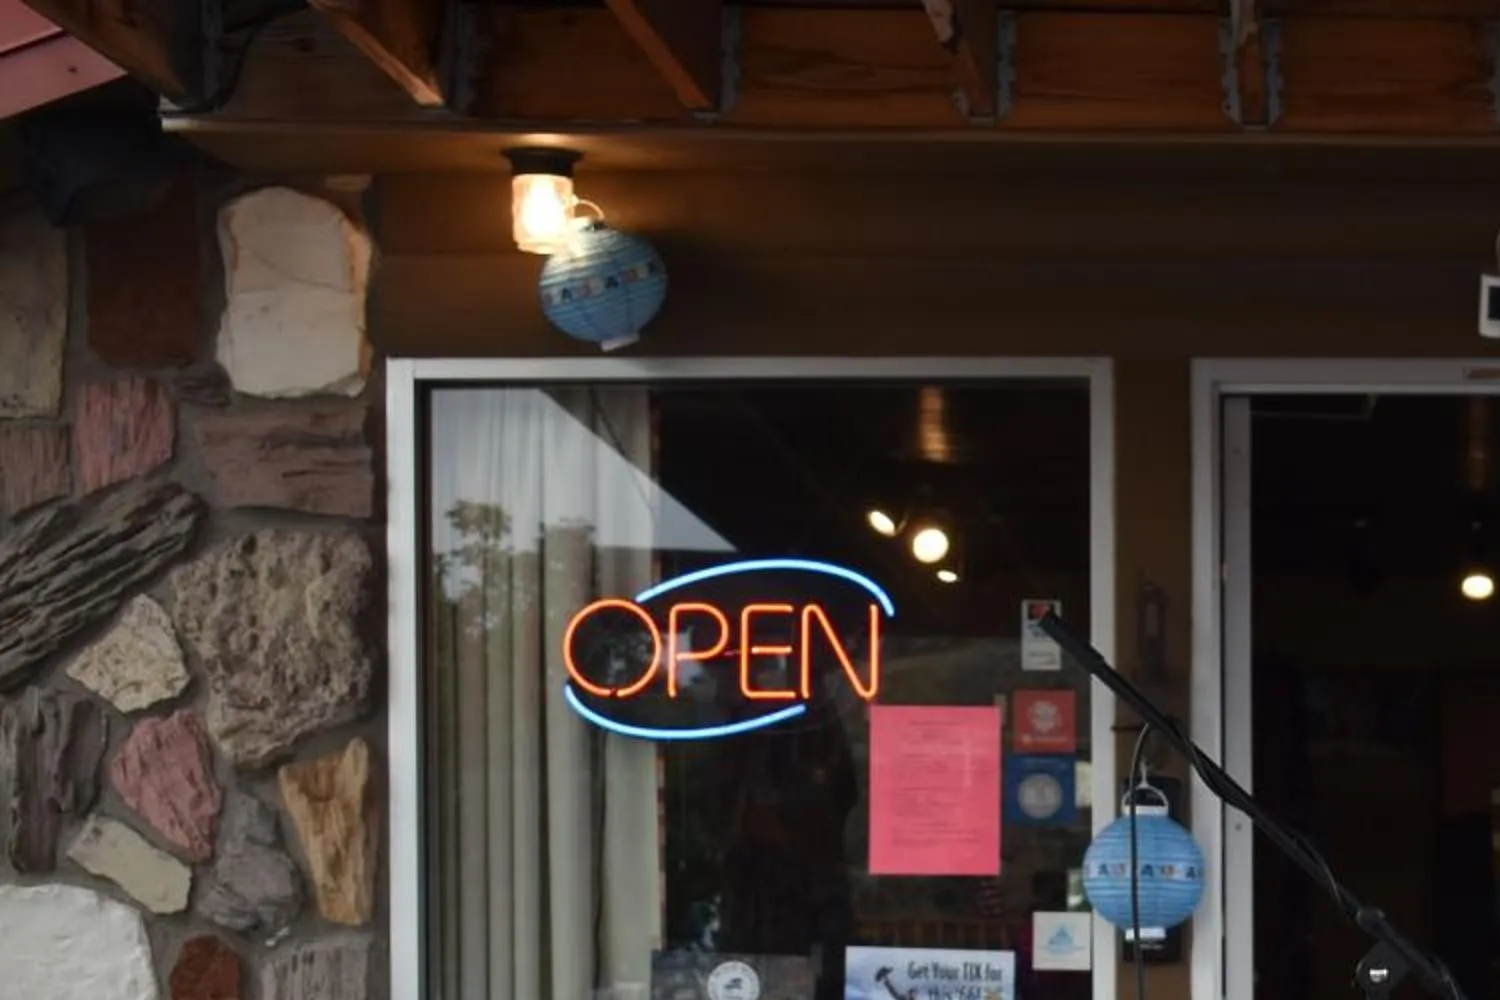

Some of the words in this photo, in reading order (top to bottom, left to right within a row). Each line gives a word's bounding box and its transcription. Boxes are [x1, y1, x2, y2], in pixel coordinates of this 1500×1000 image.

[563, 599, 879, 699] OPEN
[908, 961, 930, 980] Get
[931, 961, 960, 980] Your
[962, 961, 982, 981] TIX
[985, 962, 1003, 982] for
